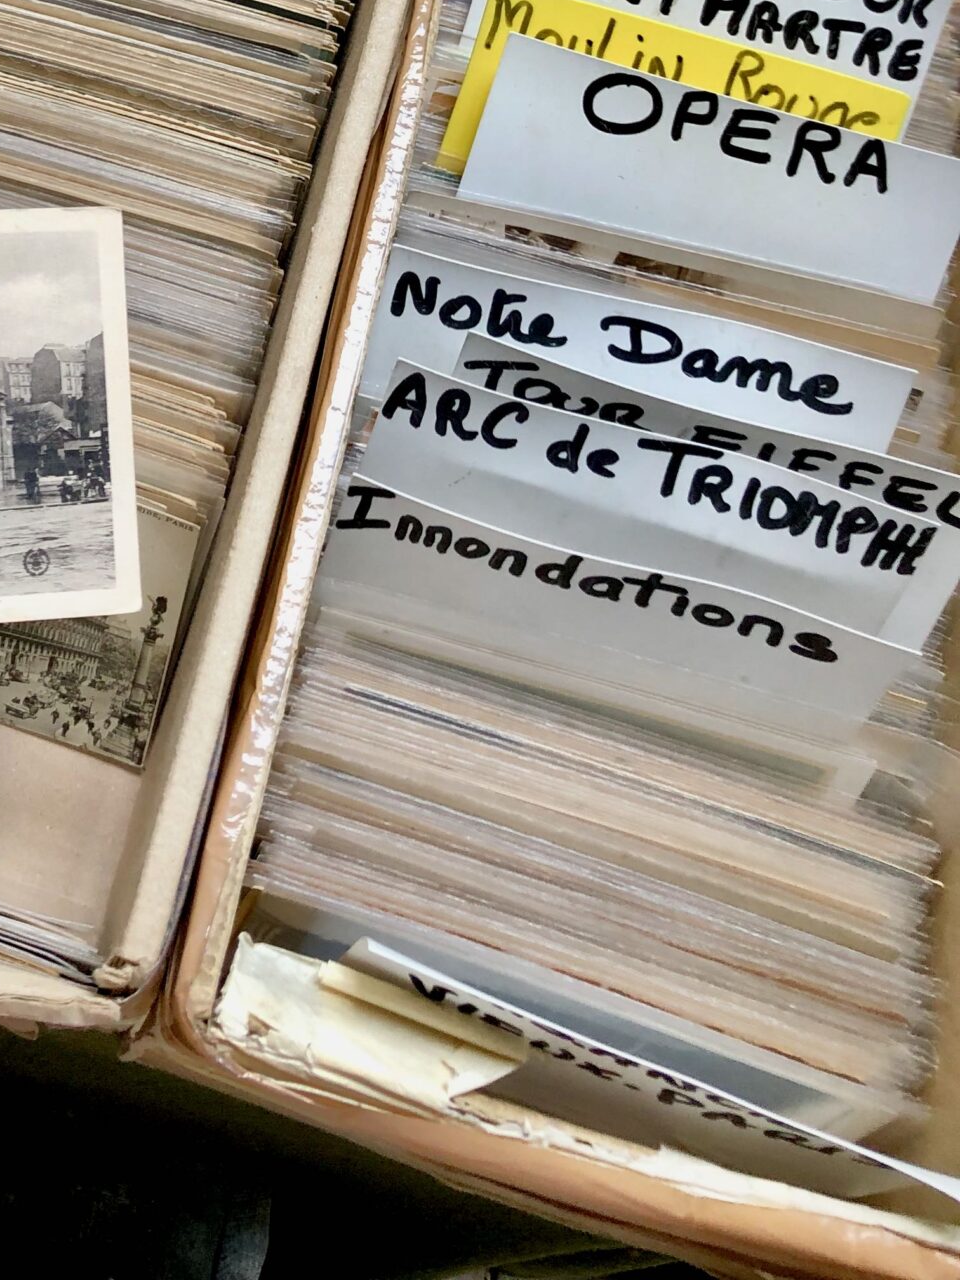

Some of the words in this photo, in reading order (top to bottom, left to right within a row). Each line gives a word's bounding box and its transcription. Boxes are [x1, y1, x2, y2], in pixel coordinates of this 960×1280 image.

[582, 72, 888, 194] OPERA
[390, 271, 568, 348] Notre
[600, 315, 853, 416] Dame
[382, 372, 530, 450] ARC
[546, 423, 620, 479] de
[335, 485, 839, 664] Innondations
